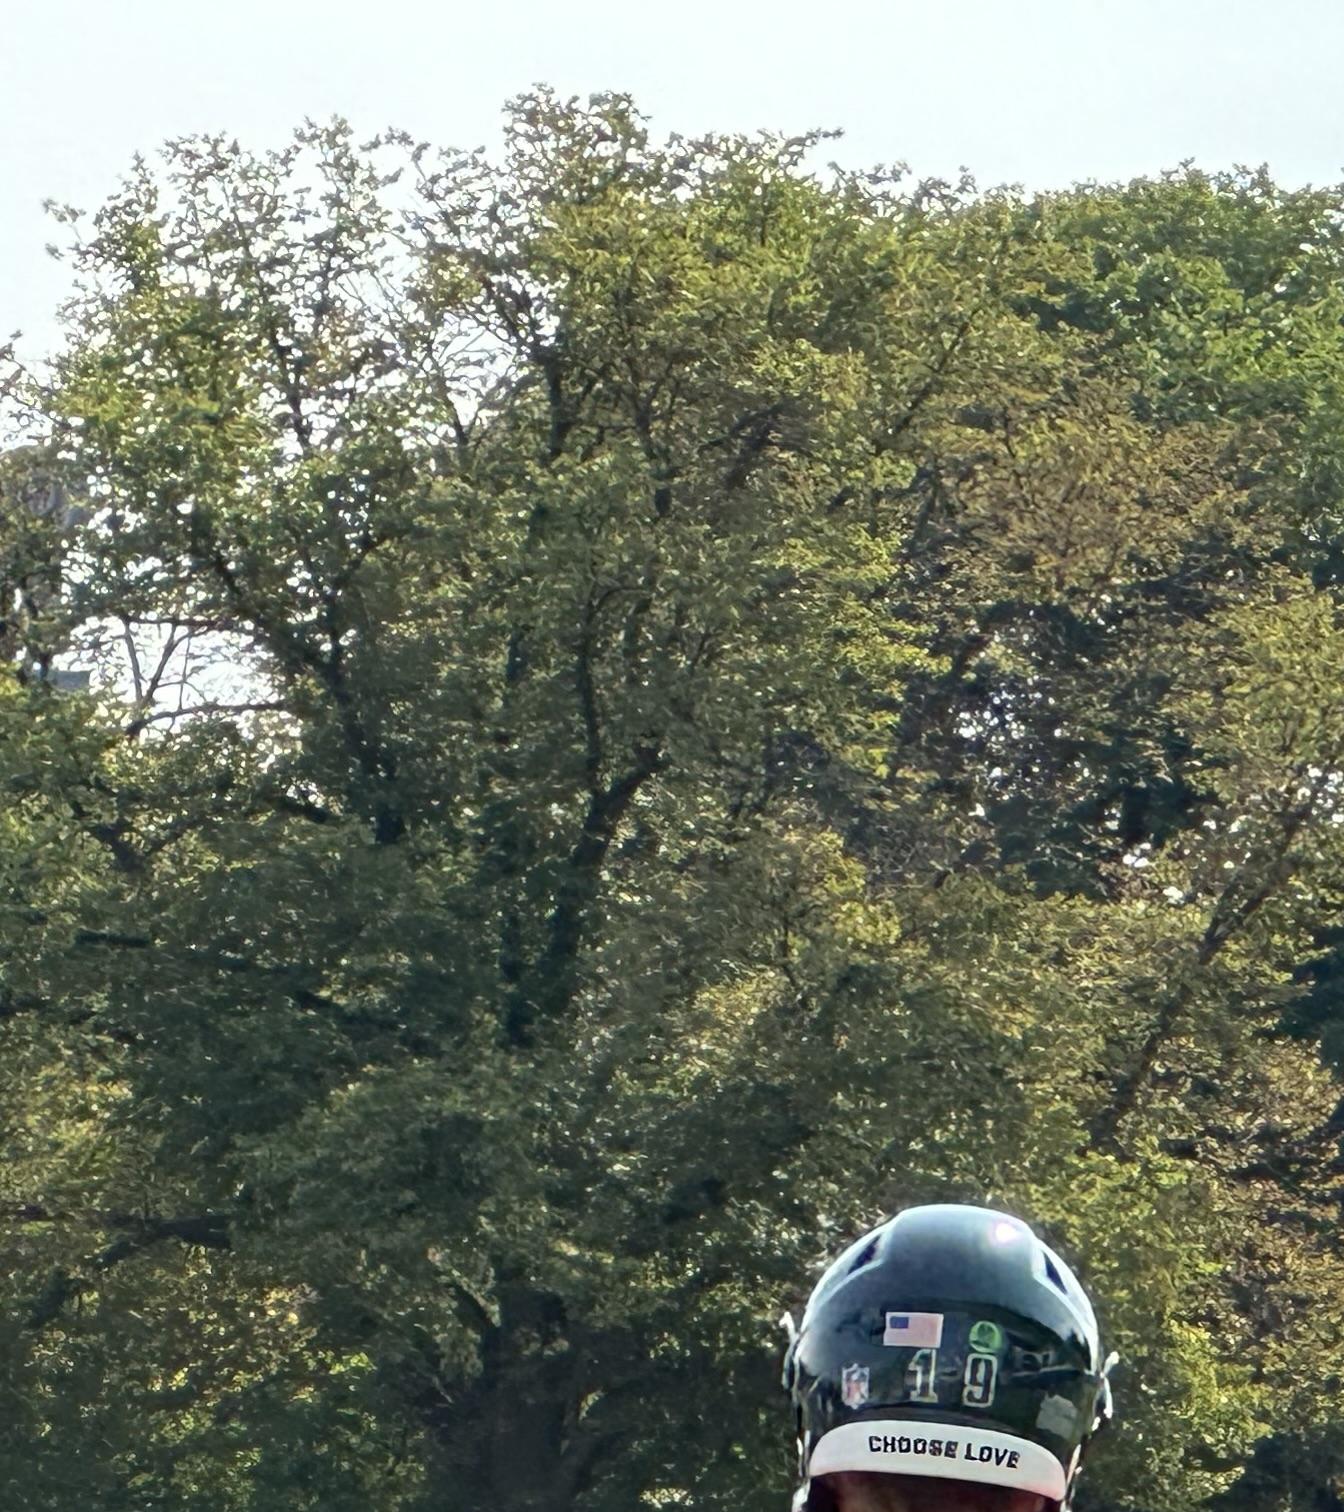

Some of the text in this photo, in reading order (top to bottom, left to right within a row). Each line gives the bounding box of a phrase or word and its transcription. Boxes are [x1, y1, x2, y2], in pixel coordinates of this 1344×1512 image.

[905, 1348, 999, 1408] 19
[868, 1435, 1021, 1469] CHOOSE LOVE
